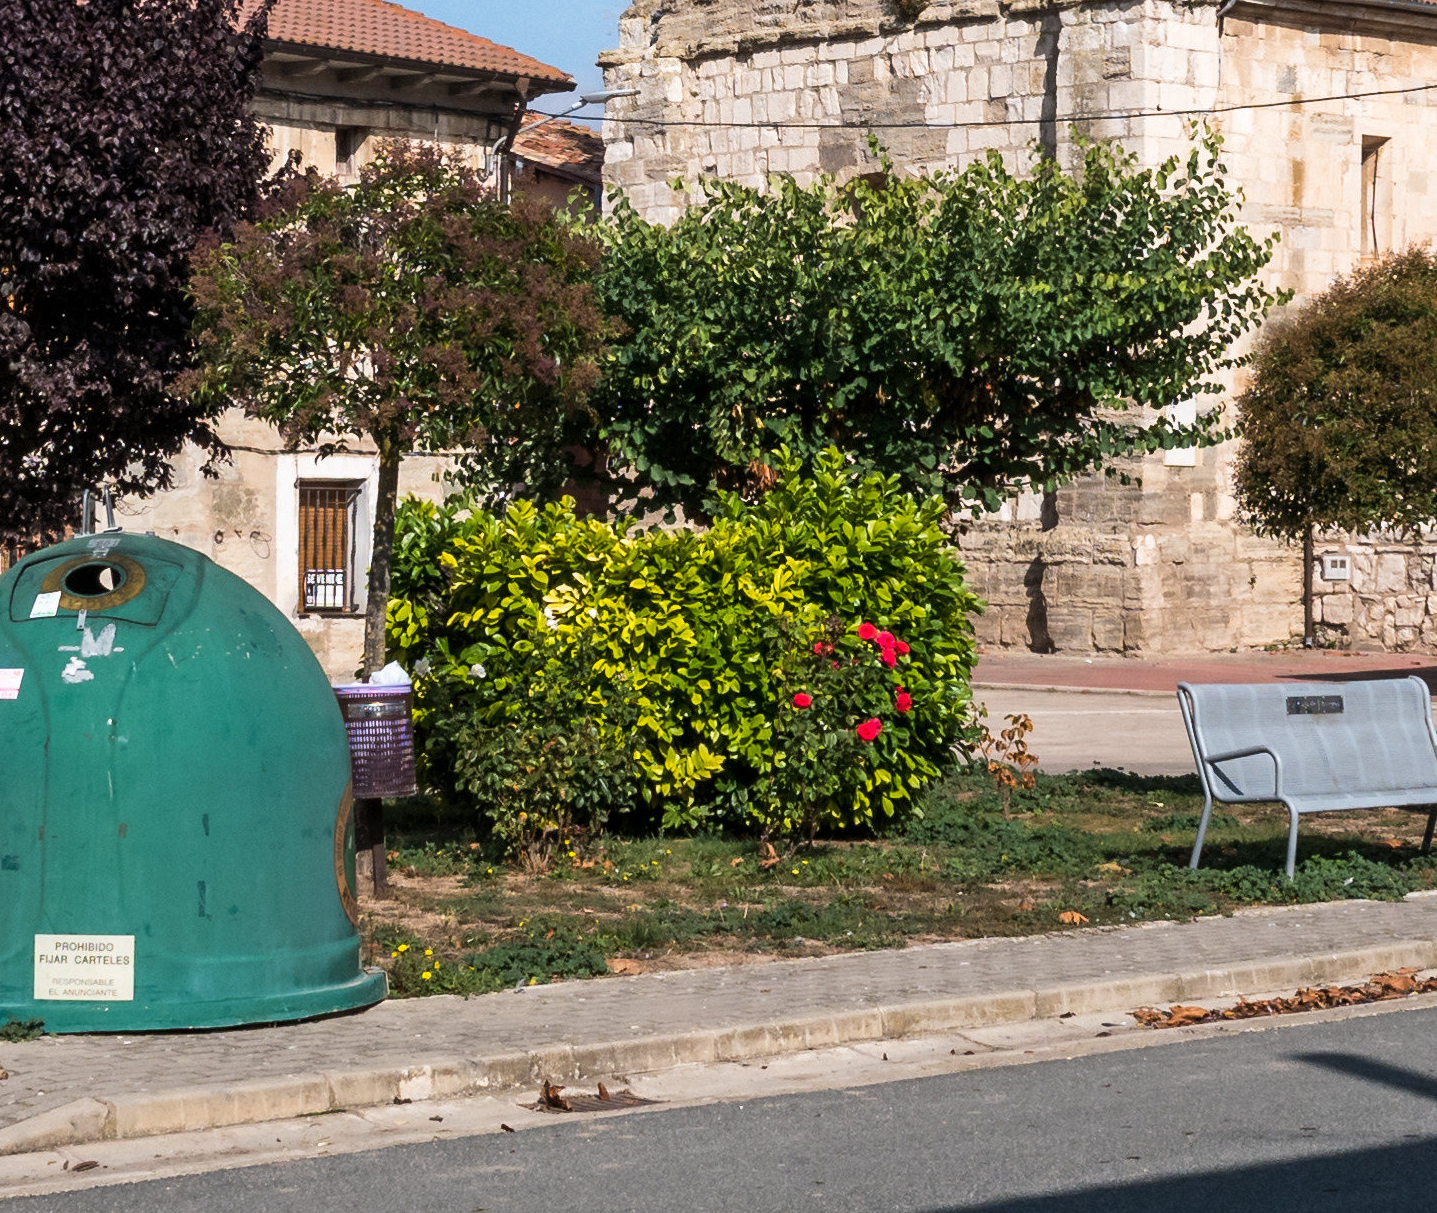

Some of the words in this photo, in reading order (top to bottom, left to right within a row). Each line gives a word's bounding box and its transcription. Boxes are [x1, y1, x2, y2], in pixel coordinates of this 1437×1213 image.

[55, 941, 114, 952] PROHIBIDO
[39, 954, 68, 964] FIJAR
[74, 955, 130, 965] CARTELES
[52, 977, 115, 986] RESPONSABLE
[48, 988, 59, 996] EL
[62, 989, 118, 997] ANUNCIANTE
